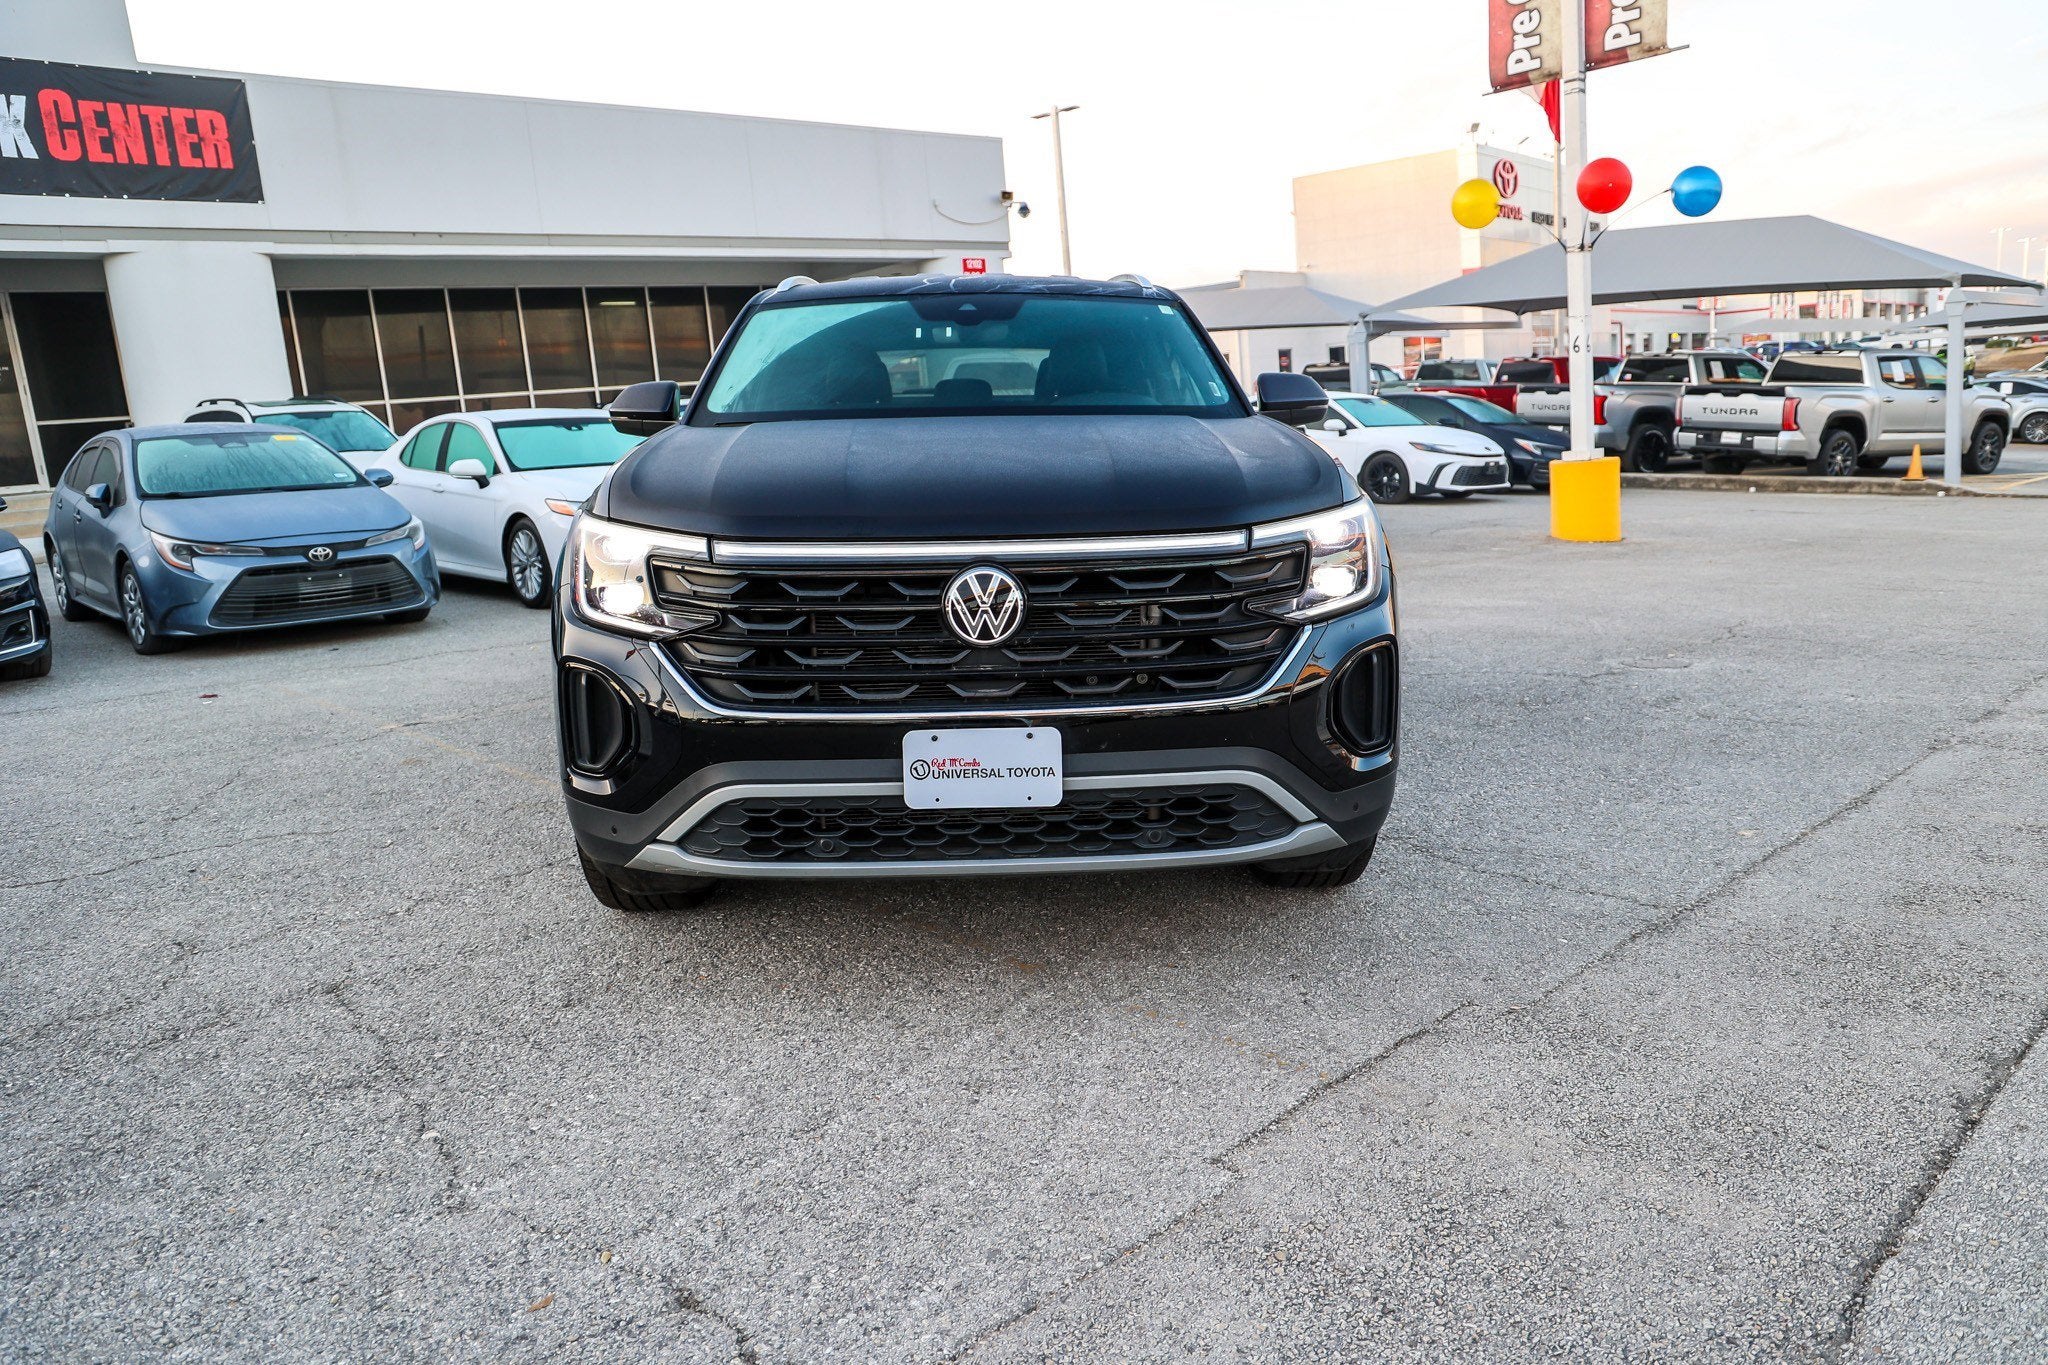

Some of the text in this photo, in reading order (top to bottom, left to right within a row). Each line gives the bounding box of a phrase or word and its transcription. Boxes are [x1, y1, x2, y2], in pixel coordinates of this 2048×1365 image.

[37, 88, 234, 169] CENTER
[1702, 407, 1759, 415] TUNDRA
[931, 758, 946, 771] Red
[932, 766, 1056, 779] UNIVERSAL TOYOTA
